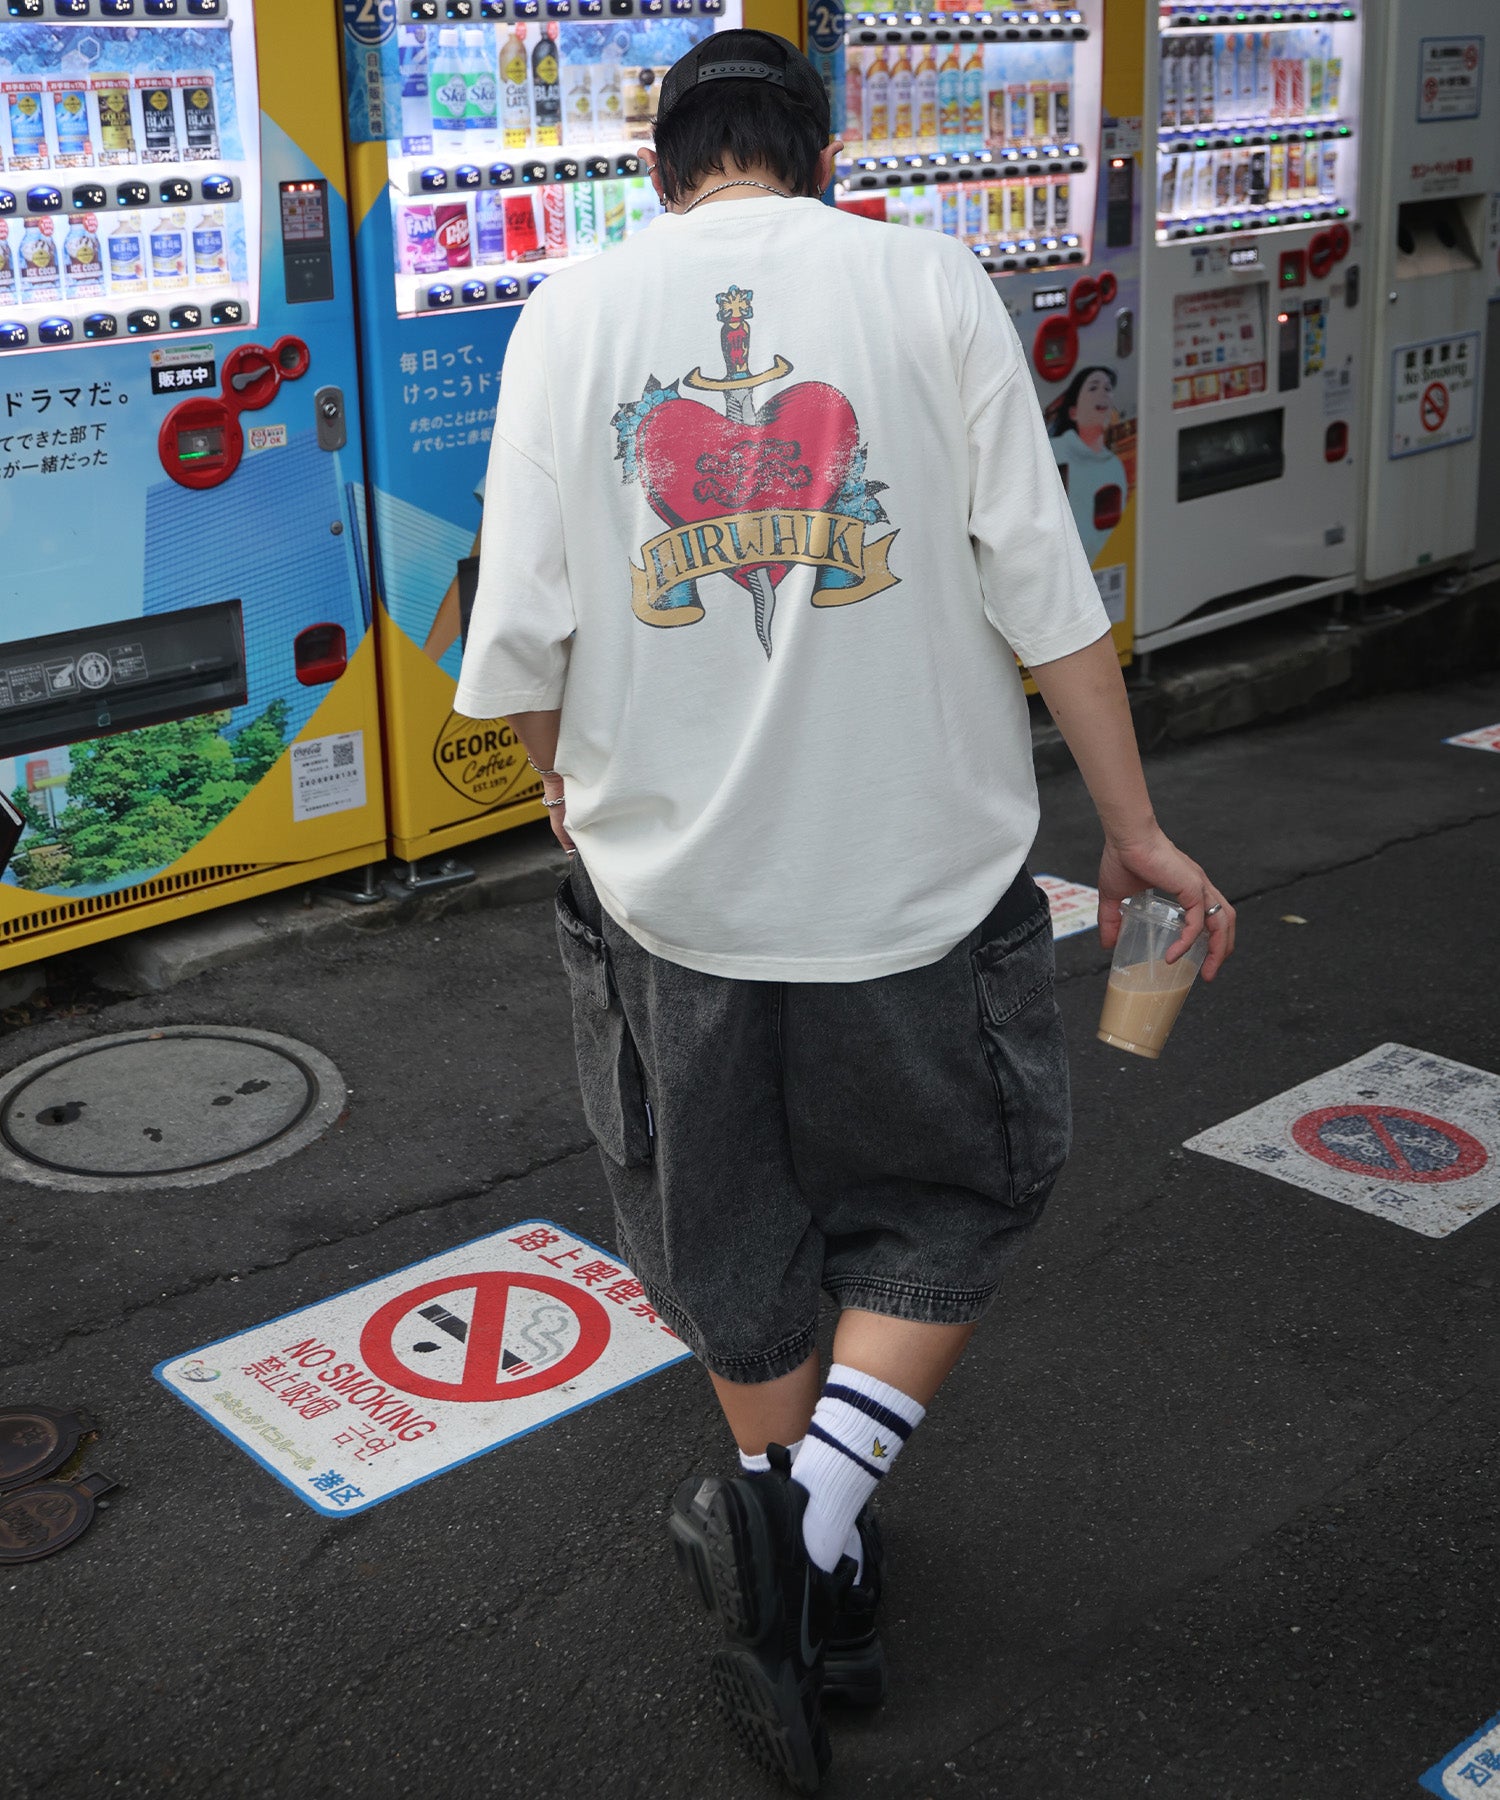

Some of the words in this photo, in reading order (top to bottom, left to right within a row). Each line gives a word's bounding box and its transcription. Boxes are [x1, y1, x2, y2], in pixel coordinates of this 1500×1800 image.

[400, 344, 483, 375] 毎日って、
[158, 366, 209, 388] 販売中
[6, 381, 129, 417] ドラマだ。
[0, 422, 107, 452] てできた部下
[0, 449, 108, 479] が一緒だった
[462, 752, 517, 784] Coffee
[508, 1227, 686, 1343] 路上喫煙
[282, 1338, 337, 1368] NO
[317, 1363, 437, 1442] SMOKING
[308, 1469, 366, 1507] 港区
